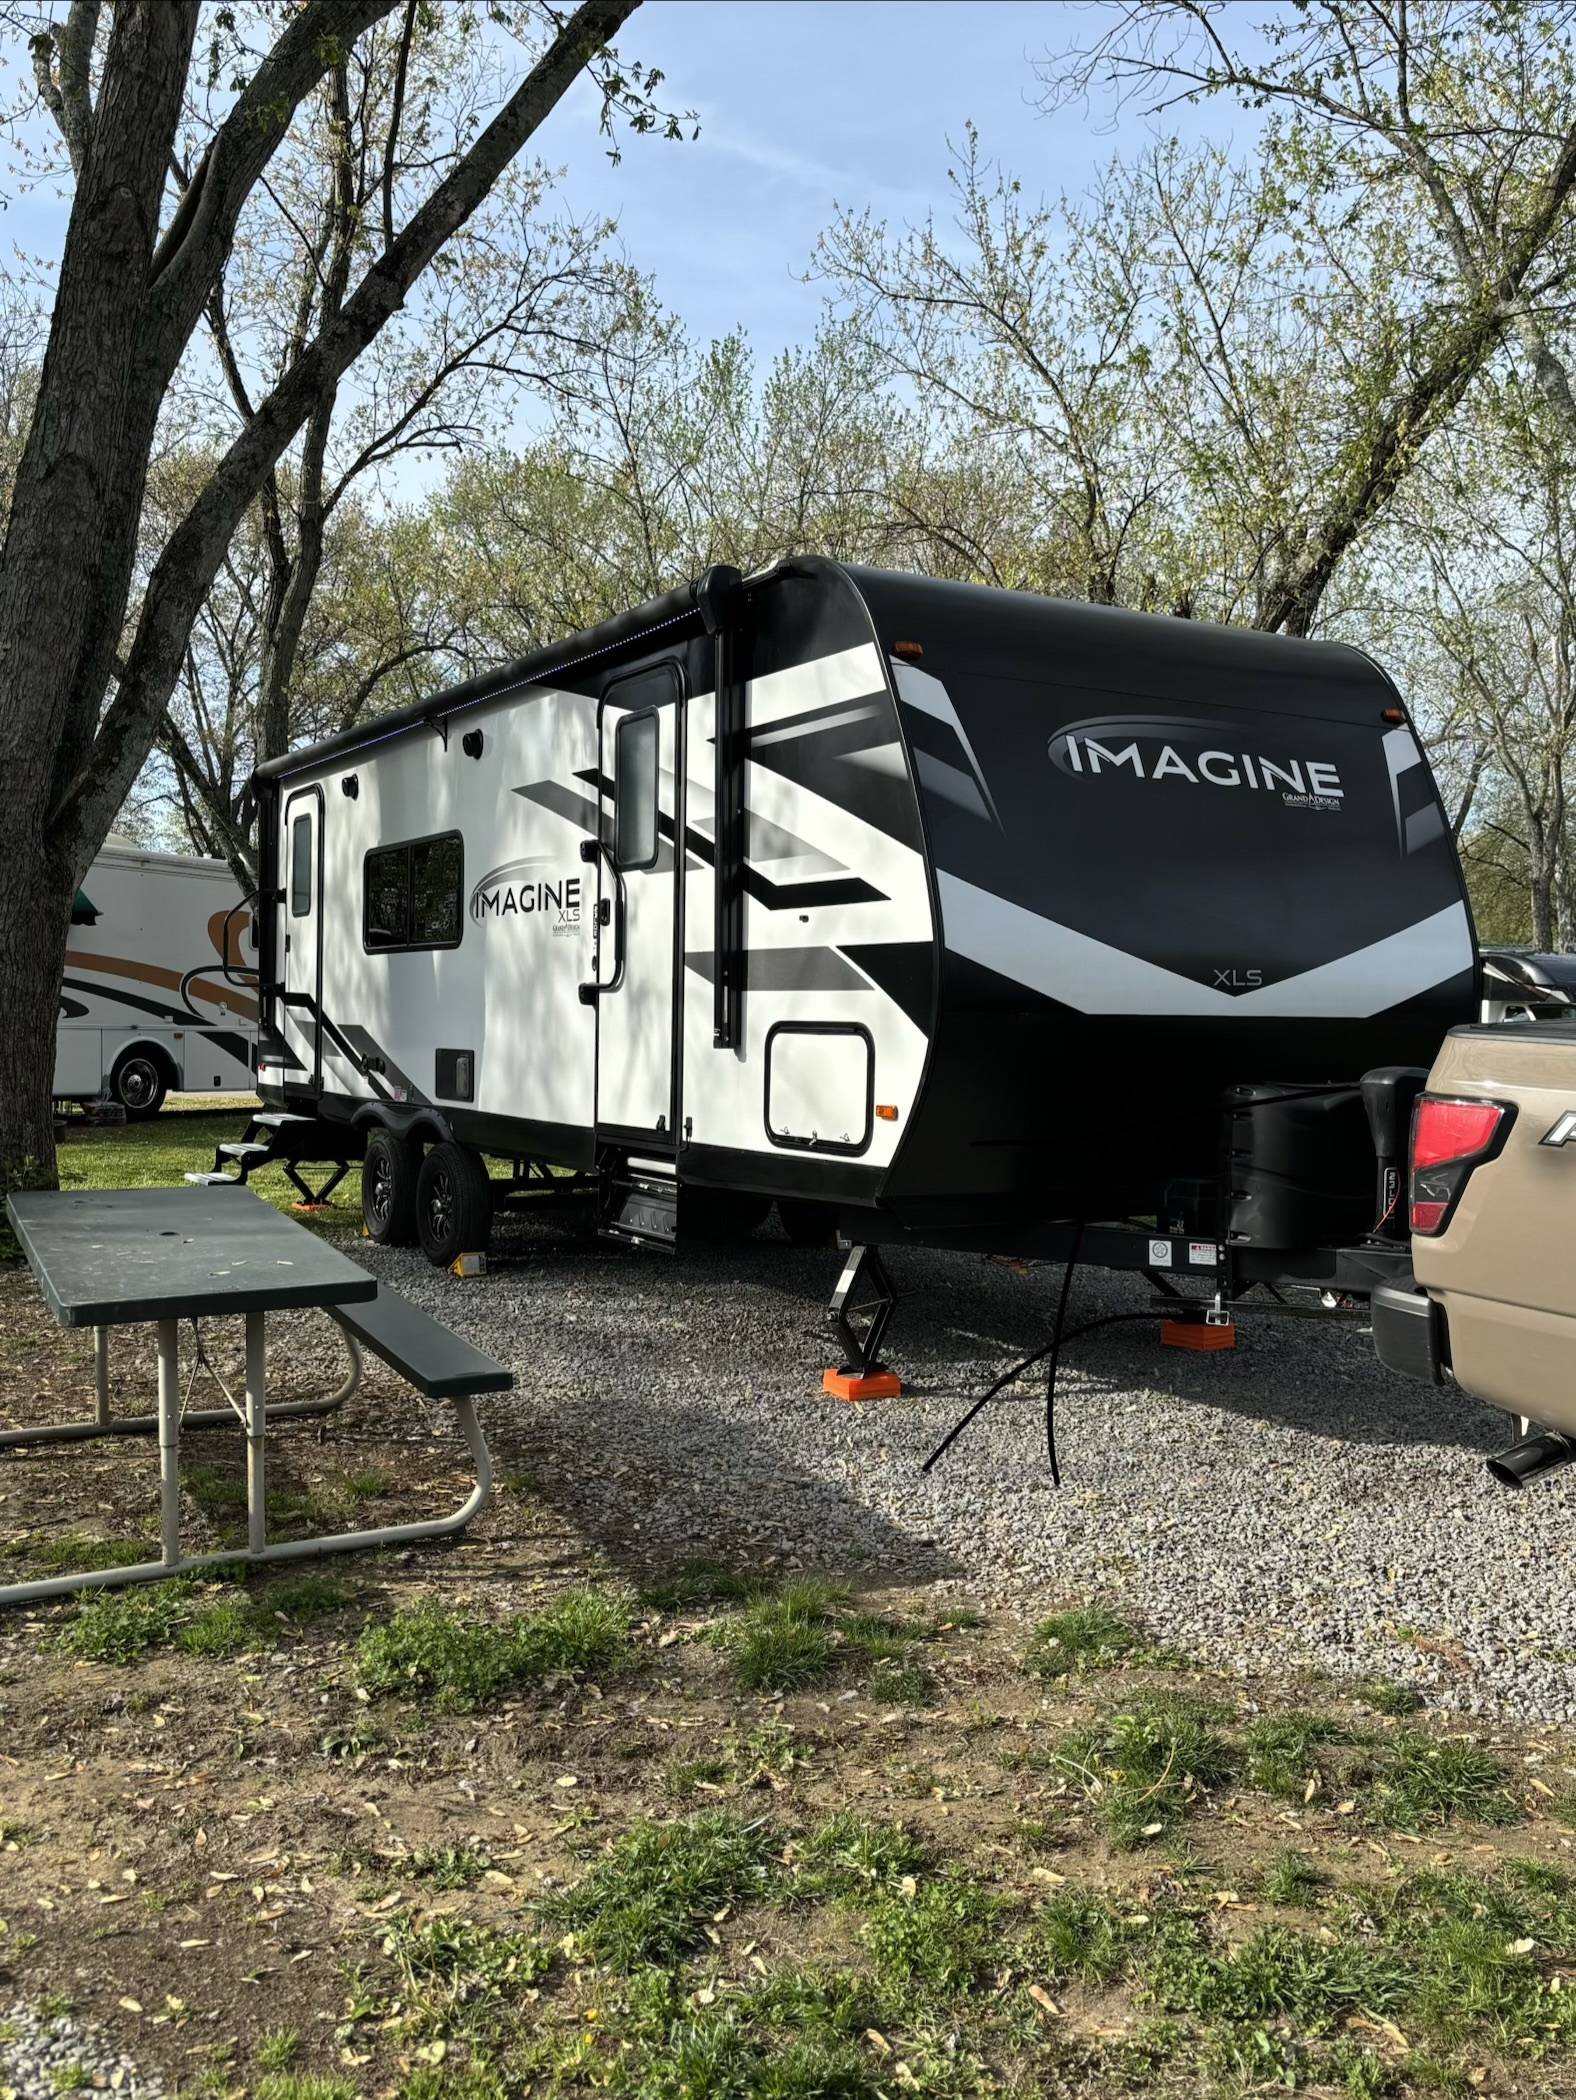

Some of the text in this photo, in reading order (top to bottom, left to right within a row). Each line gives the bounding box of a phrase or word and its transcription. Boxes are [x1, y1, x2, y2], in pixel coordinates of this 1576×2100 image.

[1065, 734, 1344, 797] IMAGINE
[475, 878, 580, 918] IMAGINE
[558, 908, 581, 923] XLS
[1213, 969, 1263, 986] XLS
